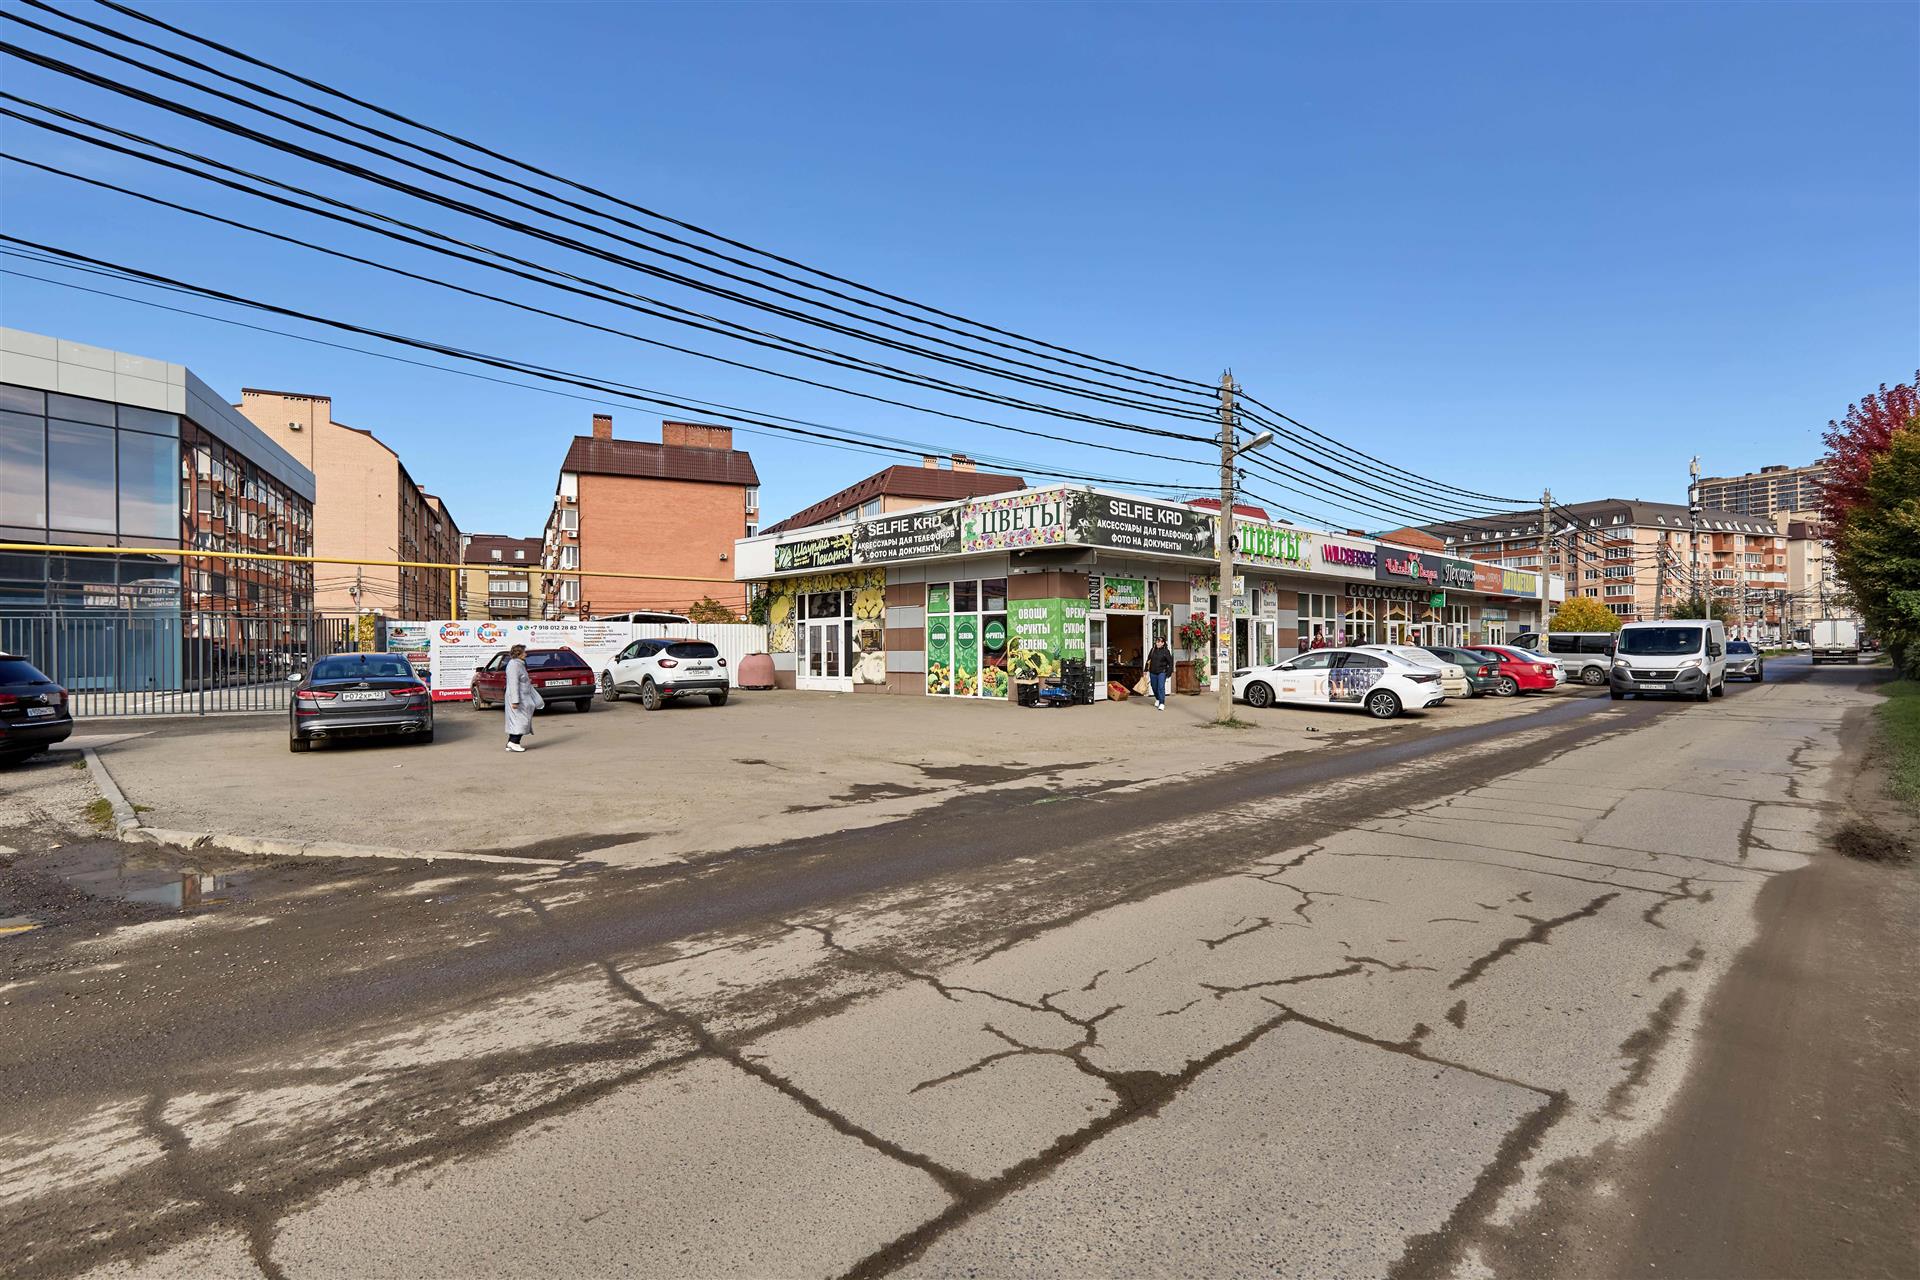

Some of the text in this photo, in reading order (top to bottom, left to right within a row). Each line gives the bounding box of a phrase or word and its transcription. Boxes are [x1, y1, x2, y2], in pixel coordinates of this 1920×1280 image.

[981, 501, 1062, 538] ЦВЕТЫ
[1109, 500, 1183, 526] SELFIE_KRD
[868, 515, 942, 537] SELFIE_KRD
[1097, 519, 1193, 541] АКСЕССУАРЫ ДЛЯ ТЕЛЕФОНОВ
[858, 537, 897, 550] АКСЕССУАРЫ
[898, 536, 913, 546] ДЛЯ
[914, 530, 955, 543] ТЕЛЕФОНОВ
[1111, 533, 1182, 551] ФОТО НА ДОКУМЕНТЫ
[1240, 525, 1300, 560] ЦВЕТЫ
[813, 547, 851, 567] Пекарня
[869, 543, 941, 560] ФОТО НА ДОКУМЕНТЫ
[1322, 543, 1378, 567] WILDBERRIES
[1018, 608, 1048, 619] ОВОЩИ
[958, 632, 974, 640] ЗЕЛЕНЬ
[985, 631, 1005, 640] ФРУКТЫ
[1016, 623, 1050, 634] ФРУКТЫ
[1018, 638, 1048, 650] ЗЕЛЕНЬ
